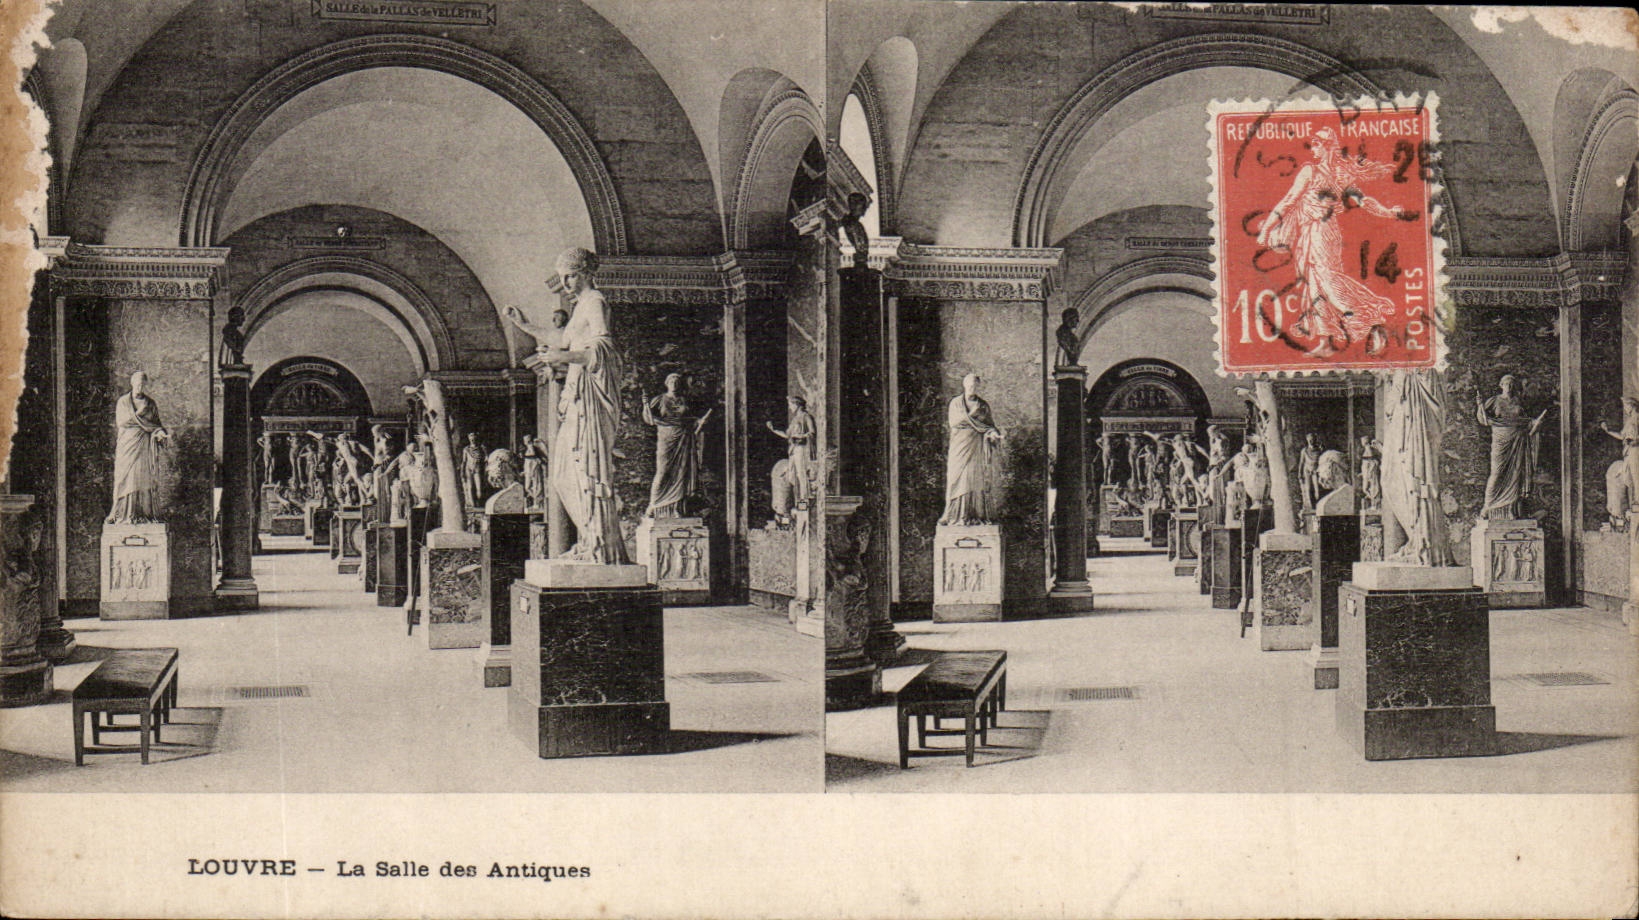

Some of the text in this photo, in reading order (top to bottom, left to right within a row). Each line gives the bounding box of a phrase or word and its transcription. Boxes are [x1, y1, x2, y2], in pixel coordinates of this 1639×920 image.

[326, 3, 360, 13] SALLE
[380, 5, 419, 16] PALLAS
[431, 7, 482, 18] VELLETRI
[1339, 117, 1420, 138] FRANÇAISE
[1404, 266, 1426, 351] POSTES
